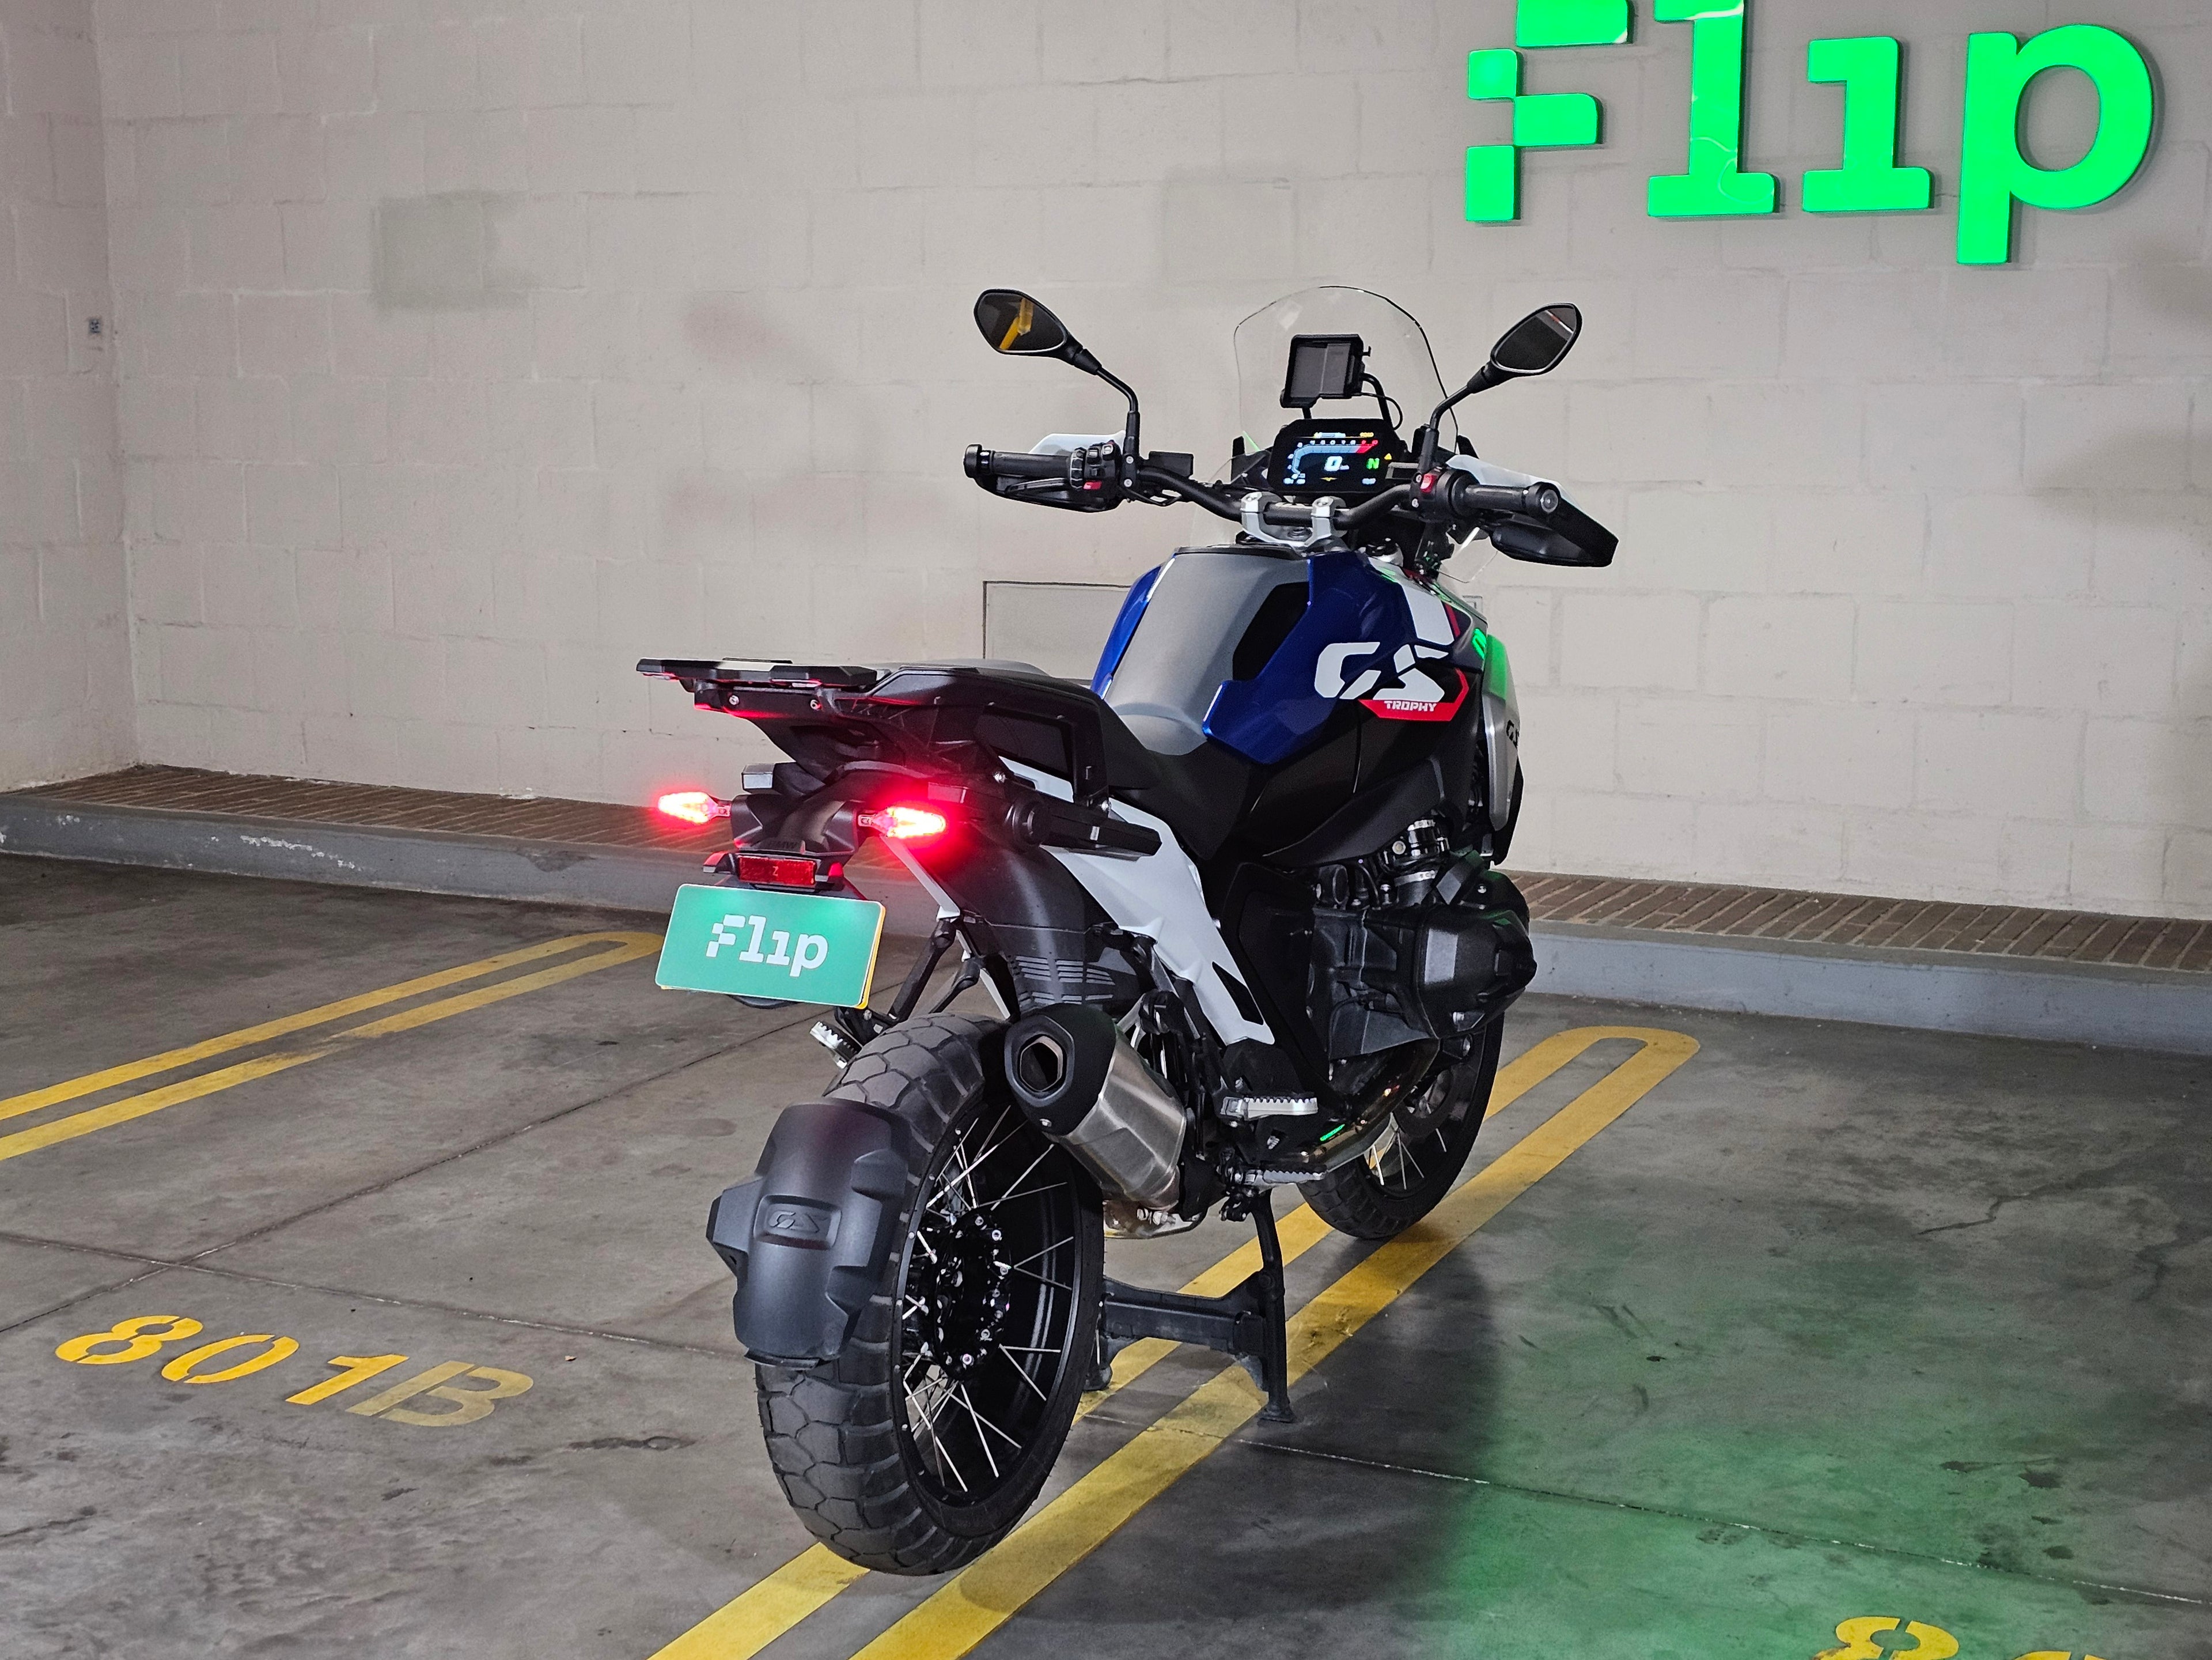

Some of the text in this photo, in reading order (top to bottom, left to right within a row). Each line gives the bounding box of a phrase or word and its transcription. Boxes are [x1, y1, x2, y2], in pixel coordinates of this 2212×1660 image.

[1366, 457, 1380, 470] N
[1315, 642, 1449, 702] GS
[1384, 700, 1437, 712] TROPHY
[706, 914, 828, 977] Flip
[55, 1314, 532, 1425] 801B
